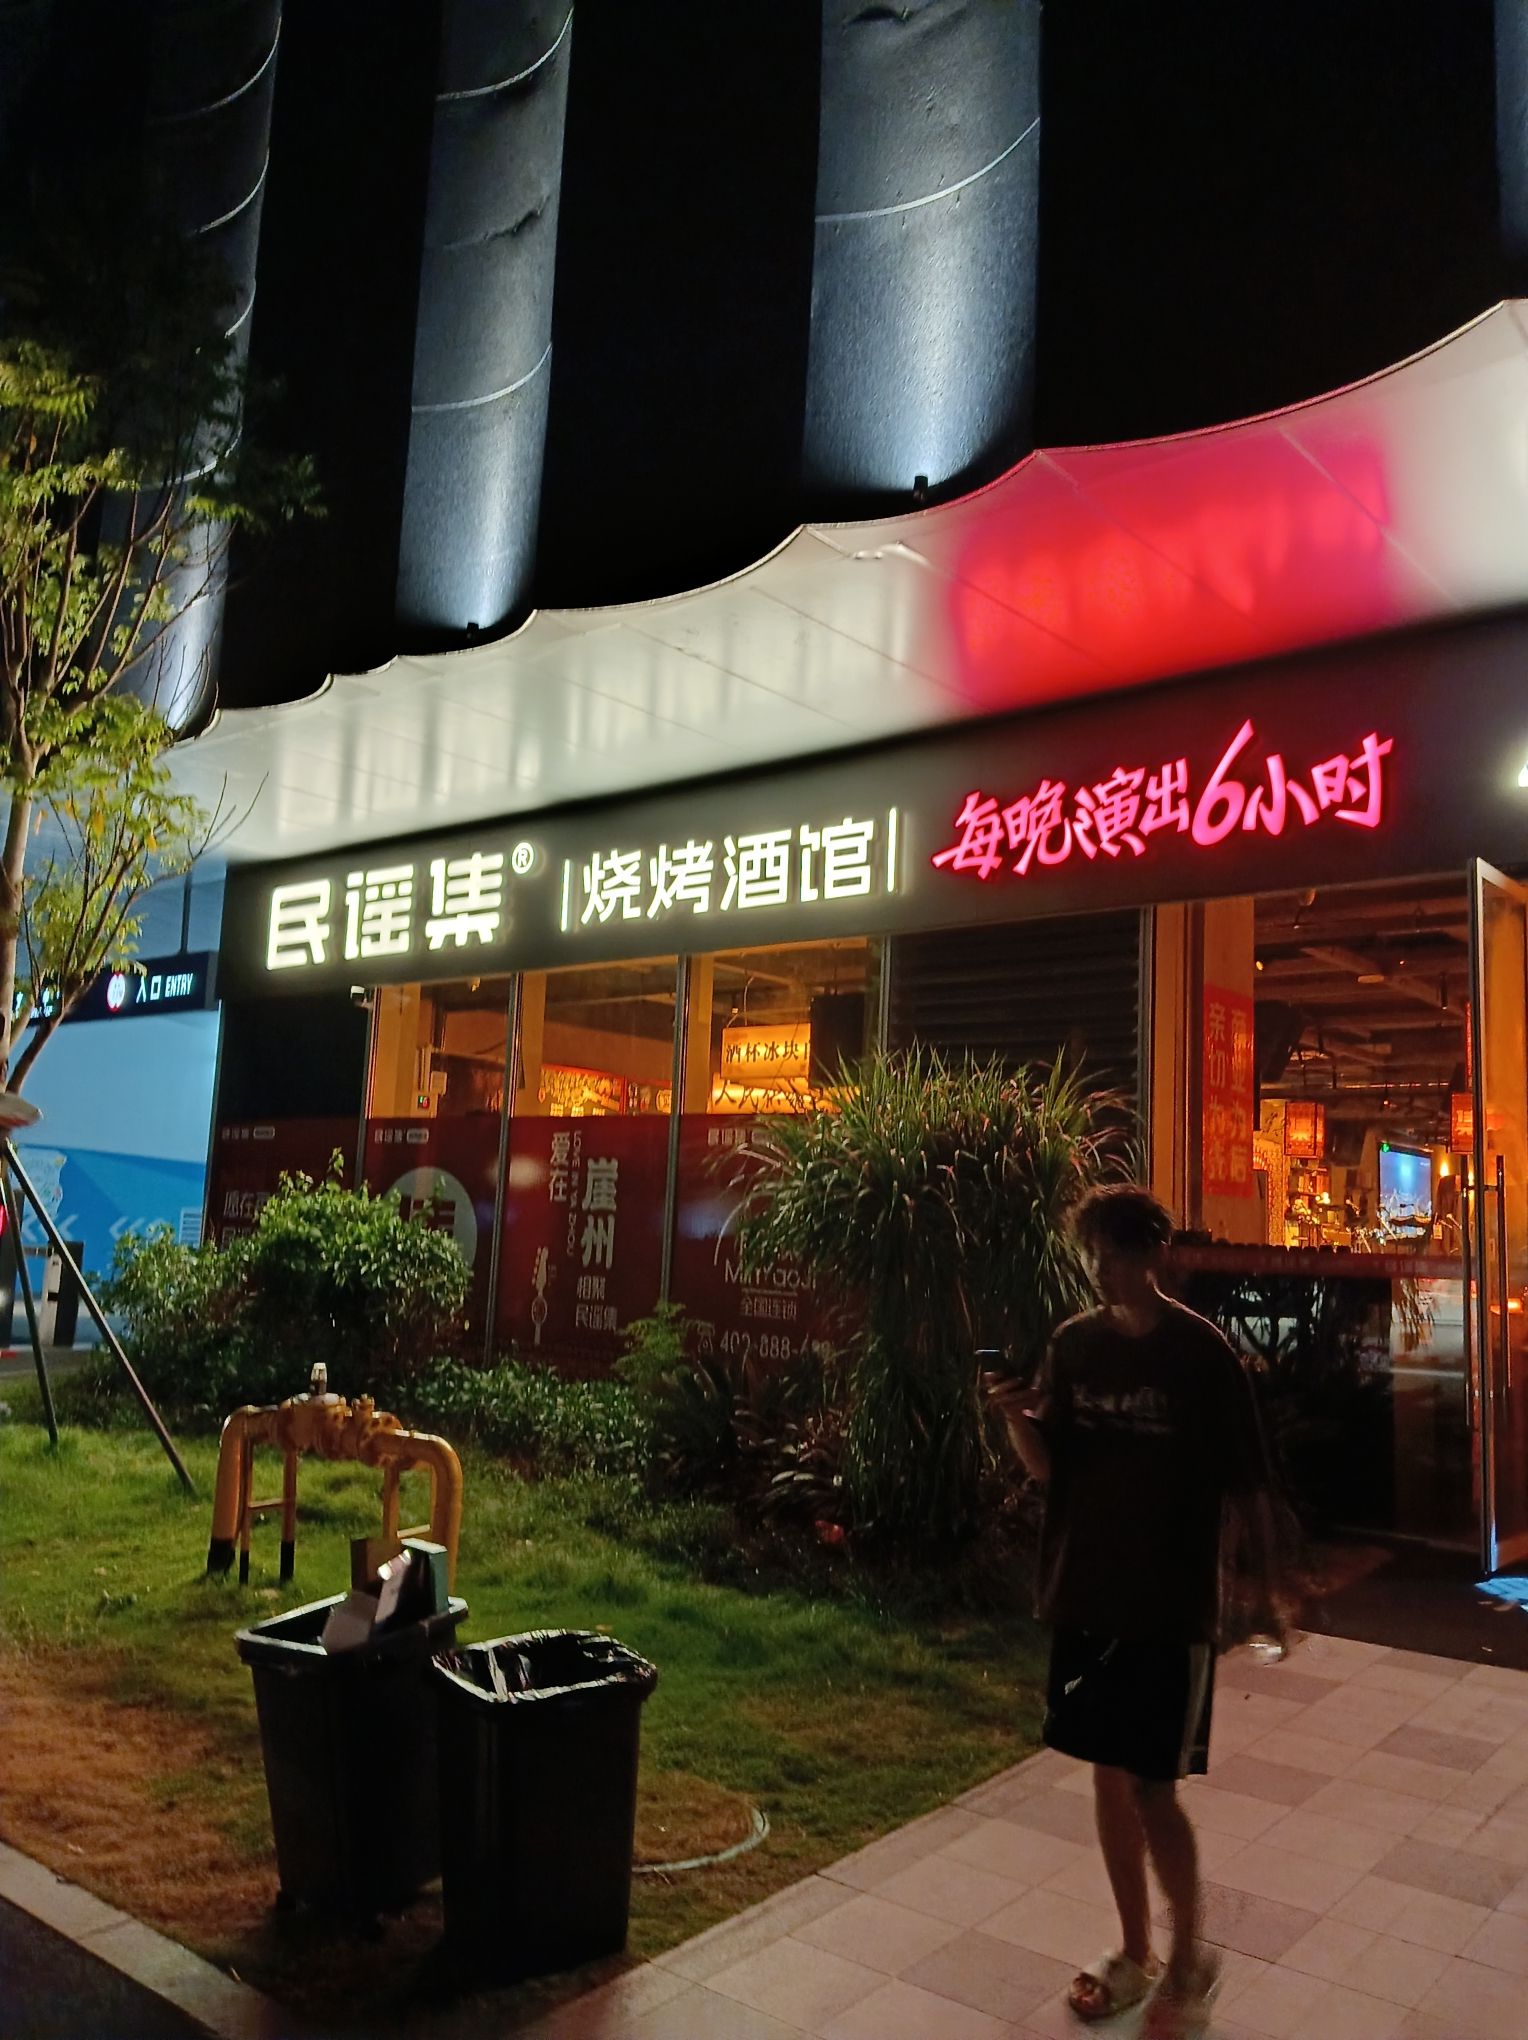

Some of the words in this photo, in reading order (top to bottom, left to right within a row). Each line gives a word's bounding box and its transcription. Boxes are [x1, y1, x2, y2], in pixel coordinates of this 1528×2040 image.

[932, 718, 1395, 880] 每晚演出6小时
[265, 851, 504, 971] 民谣集
[581, 817, 875, 925] 烧烤酒馆
[136, 975, 162, 1004] 入口
[164, 972, 194, 998] ENTRY
[549, 1131, 570, 1203] 爱在
[581, 1156, 619, 1270] 崖州
